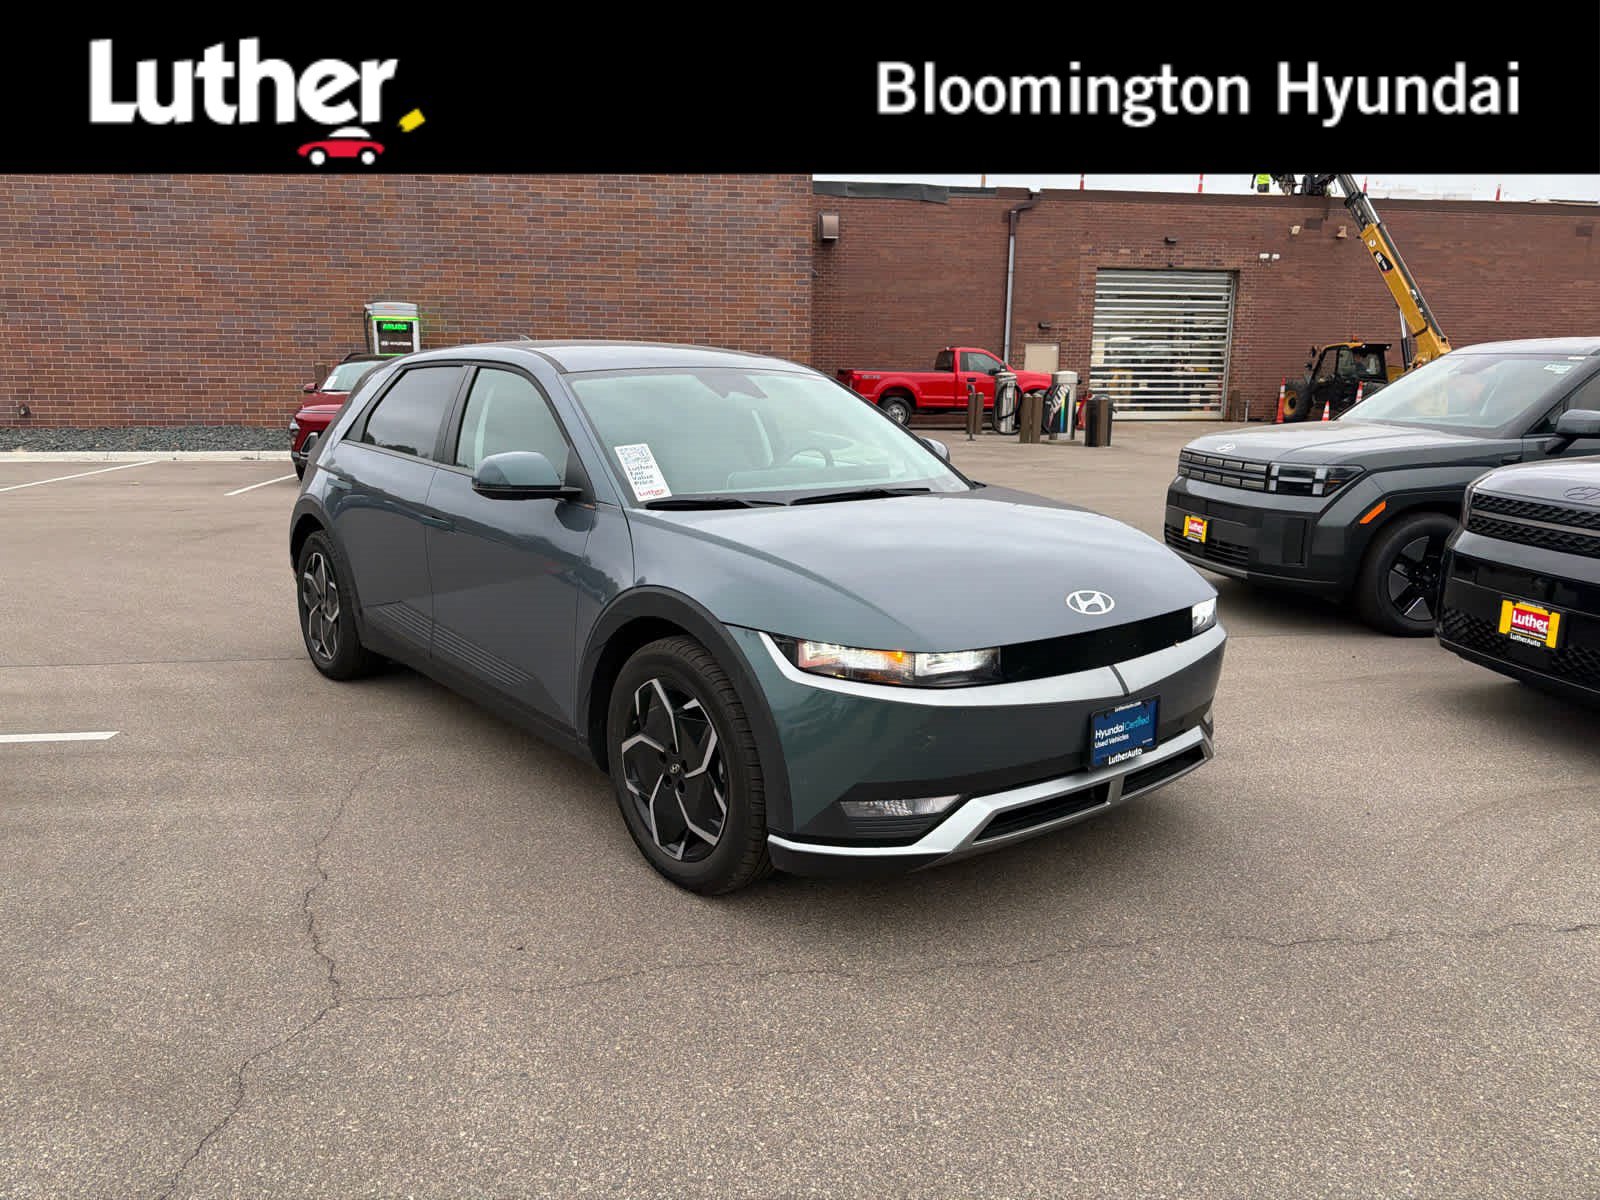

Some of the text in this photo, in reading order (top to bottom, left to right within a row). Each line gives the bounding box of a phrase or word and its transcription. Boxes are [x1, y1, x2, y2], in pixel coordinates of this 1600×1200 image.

[1512, 610, 1548, 634] Luther
[1510, 633, 1541, 647] LutherAuto
[1094, 738, 1109, 748] Used
[1109, 734, 1130, 745] Vehicles
[1108, 748, 1143, 765] LutherAuto
